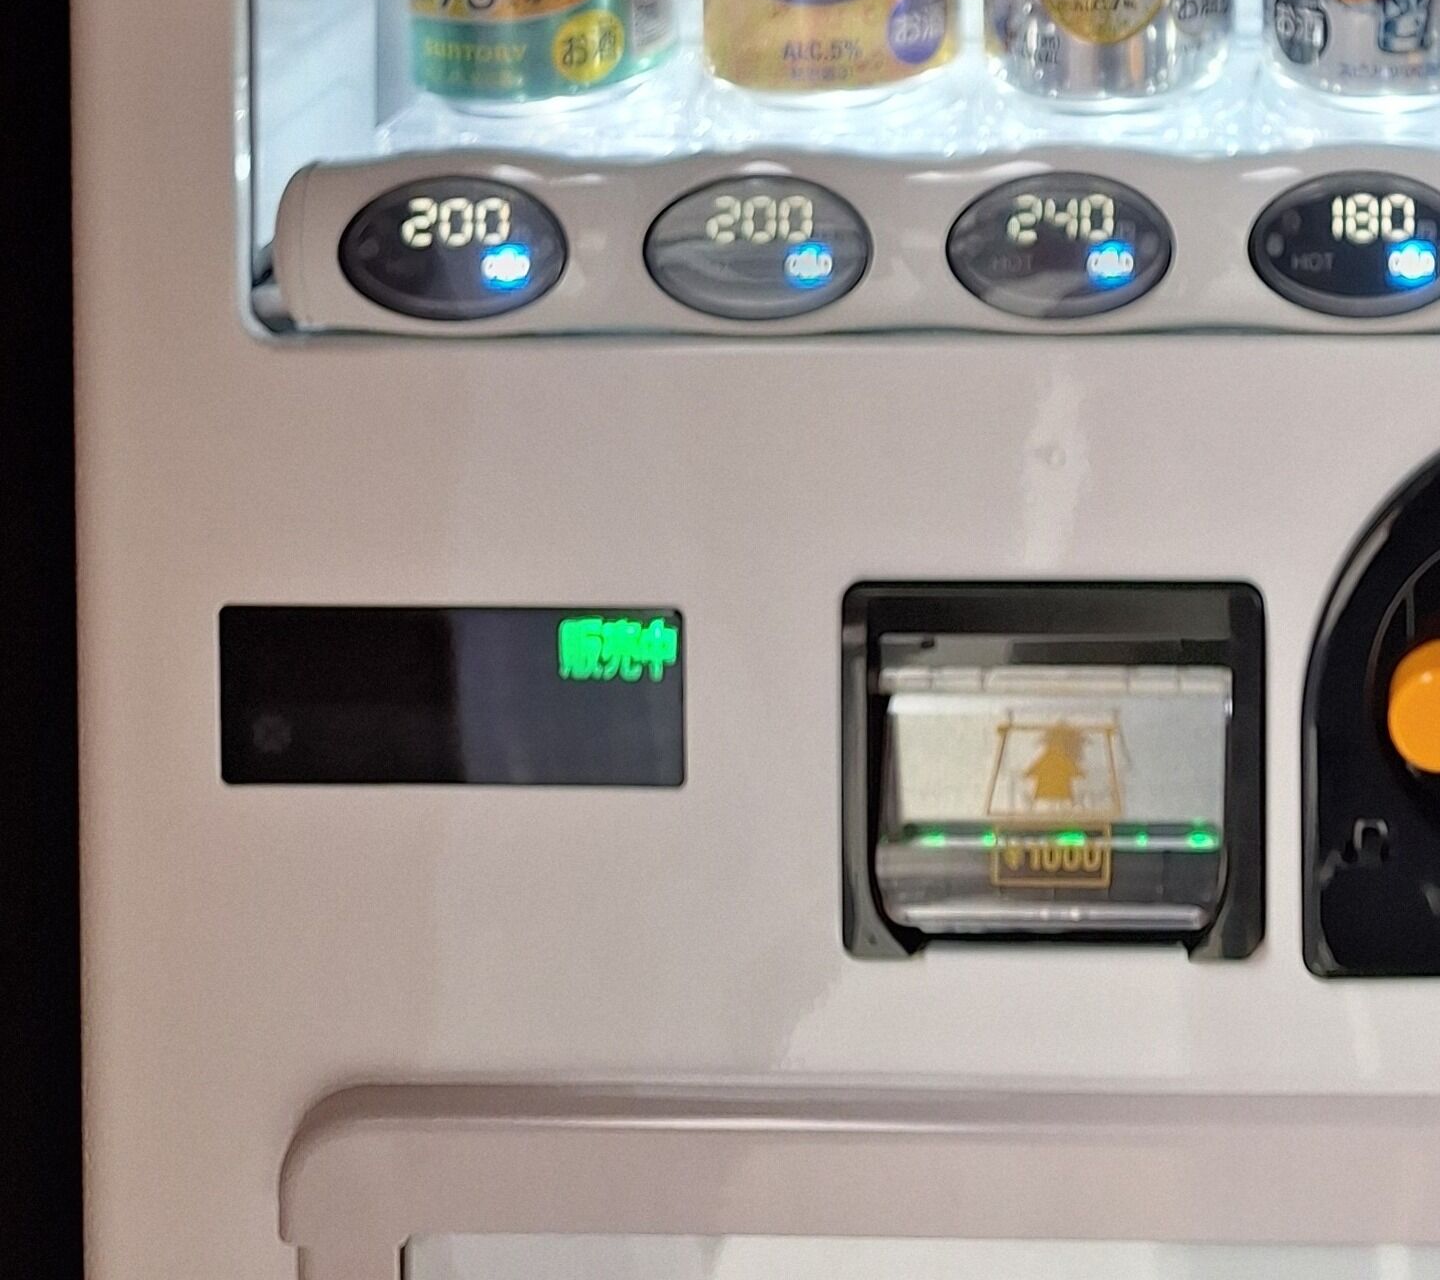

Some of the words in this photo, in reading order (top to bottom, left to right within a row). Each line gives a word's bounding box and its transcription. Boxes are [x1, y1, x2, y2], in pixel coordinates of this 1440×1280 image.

[401, 197, 510, 248] 200
[706, 195, 814, 243] 200
[1007, 193, 1114, 246] 240
[1331, 193, 1416, 244] 180
